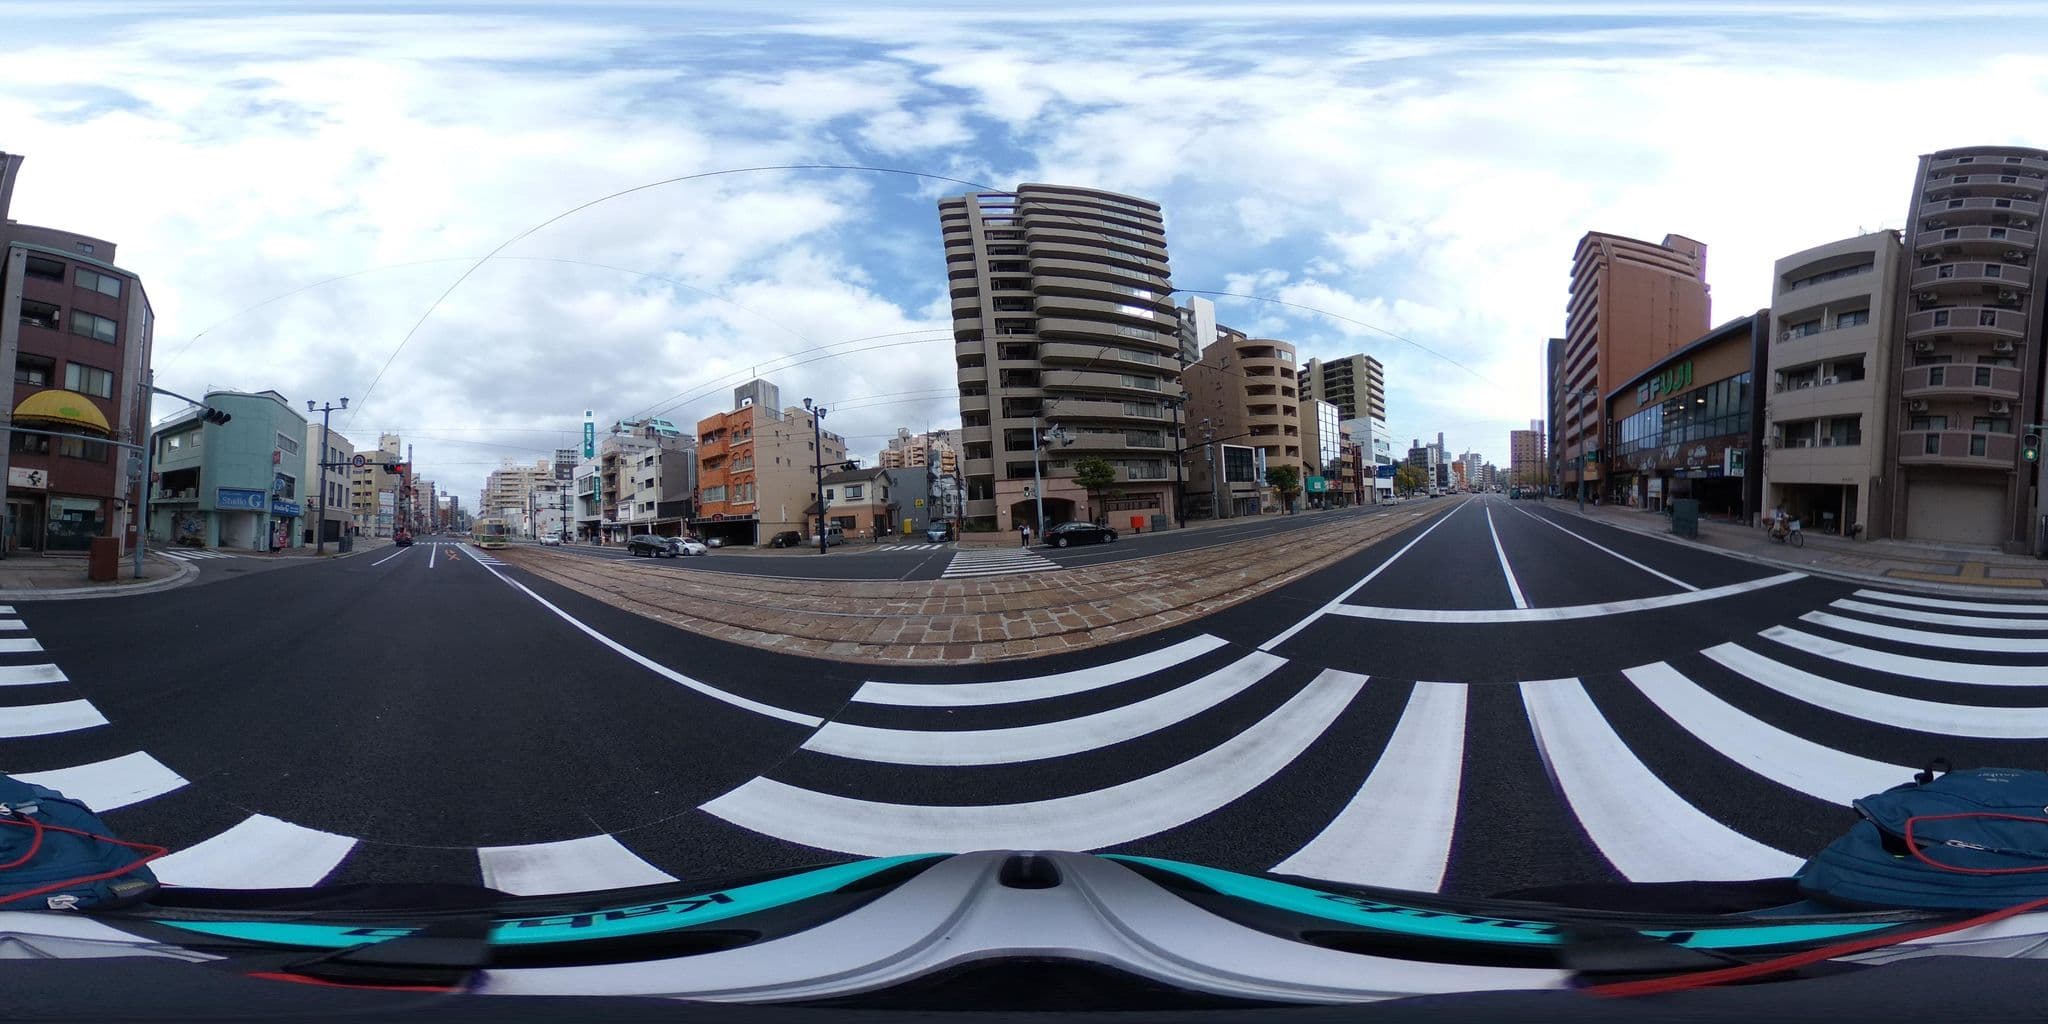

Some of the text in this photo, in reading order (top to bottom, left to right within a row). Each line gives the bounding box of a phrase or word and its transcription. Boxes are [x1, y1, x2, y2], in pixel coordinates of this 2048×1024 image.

[1649, 360, 1694, 402] FUJI
[222, 494, 262, 508] Studio G
